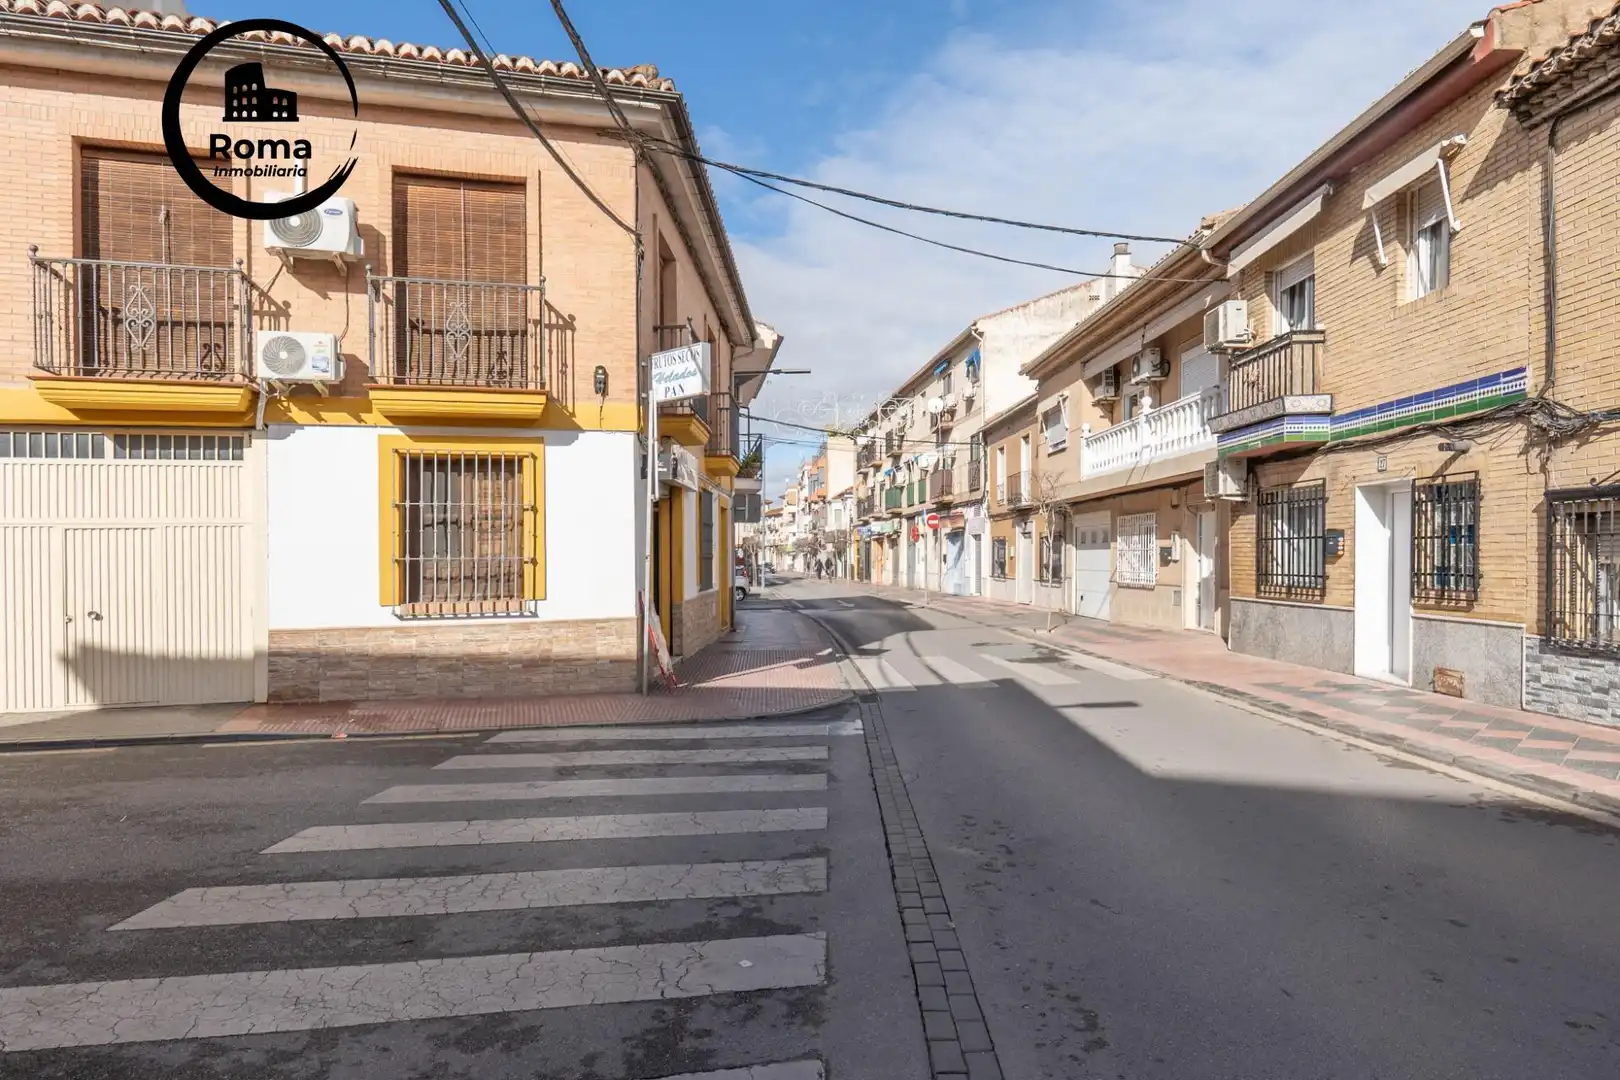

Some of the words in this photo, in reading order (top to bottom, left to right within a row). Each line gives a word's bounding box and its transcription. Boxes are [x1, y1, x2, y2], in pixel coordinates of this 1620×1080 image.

[652, 352, 677, 369] RUTOS
[653, 366, 698, 384] Helados
[664, 383, 685, 398] PAN
